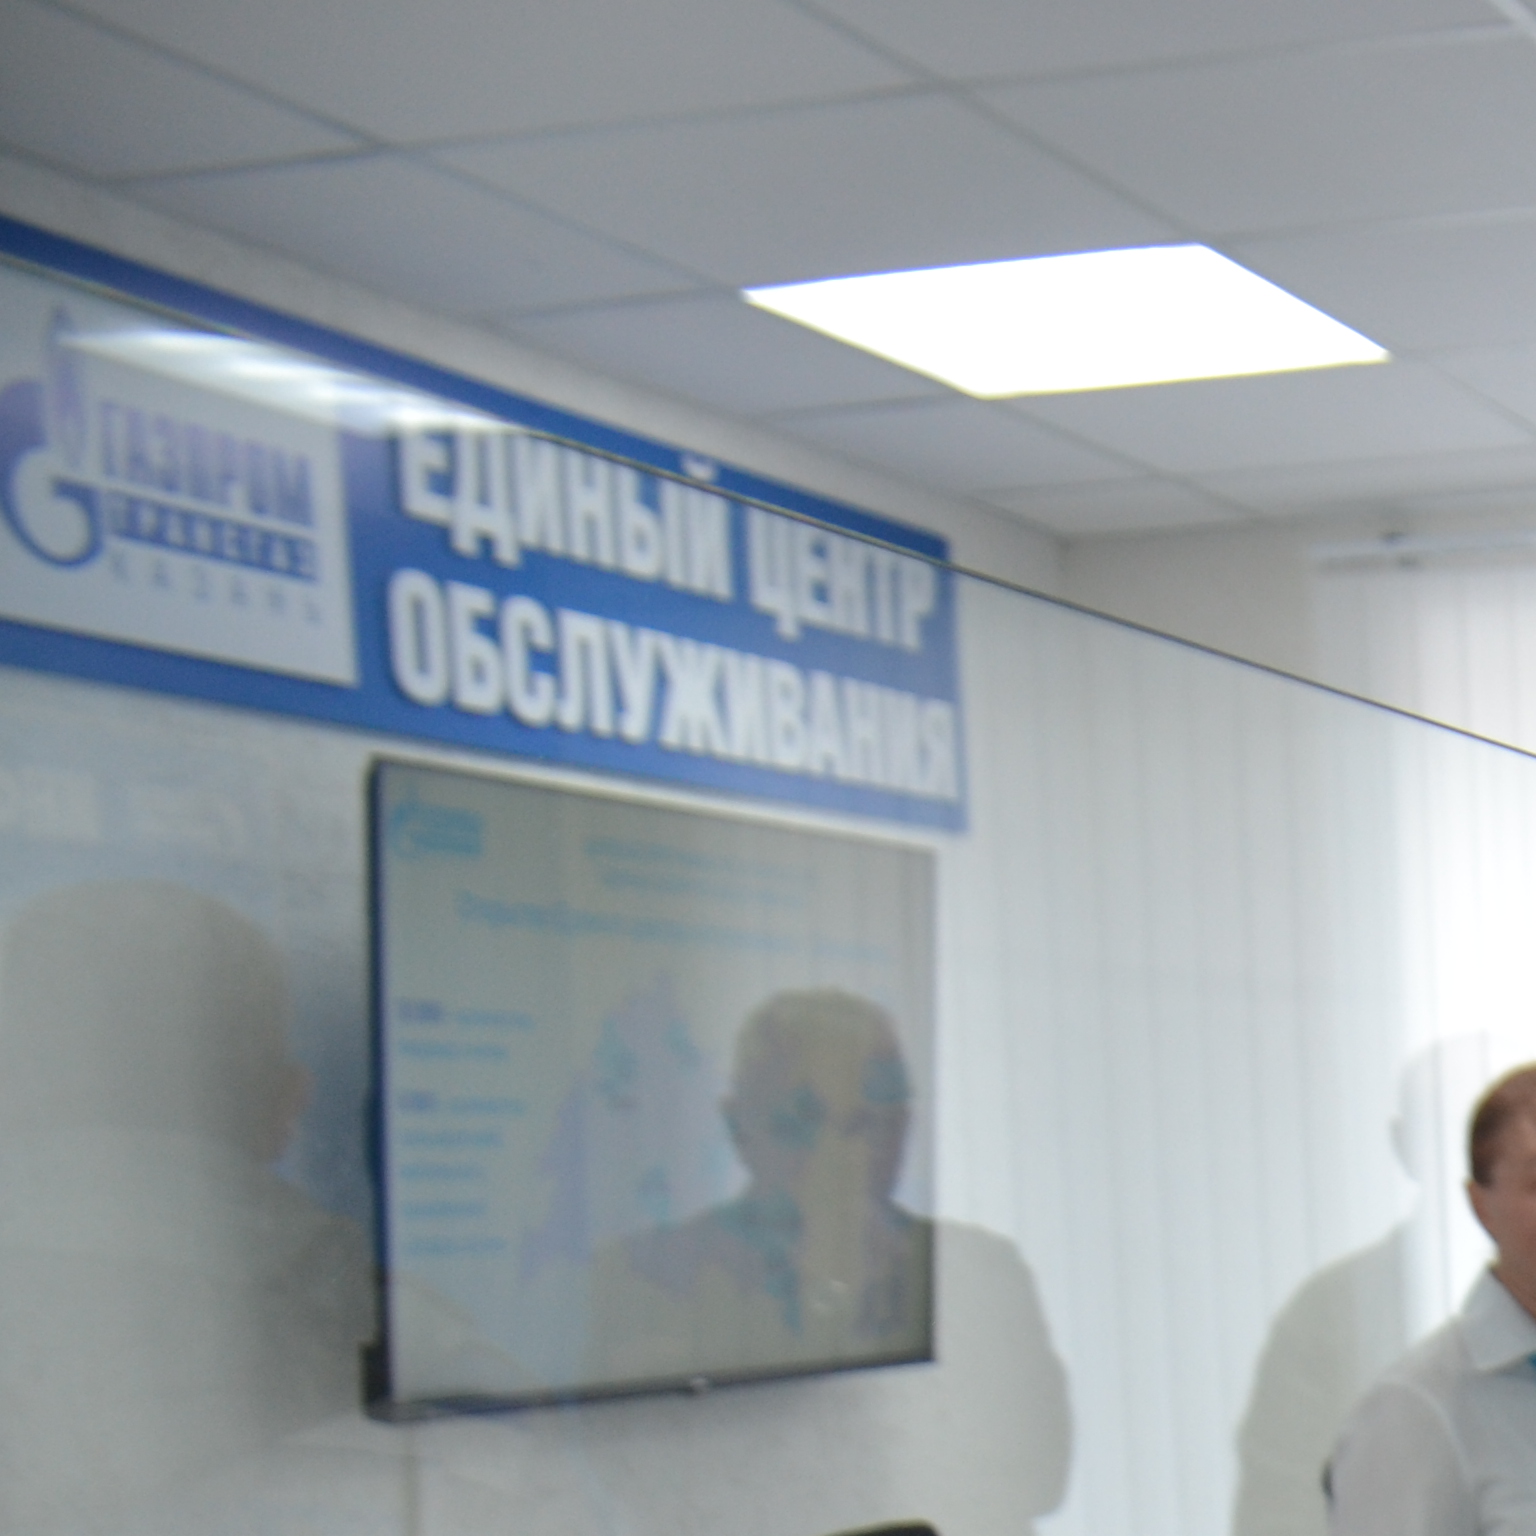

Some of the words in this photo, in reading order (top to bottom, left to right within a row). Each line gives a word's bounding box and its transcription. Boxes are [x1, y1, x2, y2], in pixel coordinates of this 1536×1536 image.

[400, 425, 732, 602] ЕДИНЫЙ
[746, 501, 937, 653] ЦЕНТР
[388, 567, 959, 800] ОБСЛУЖИВАНИЯ
